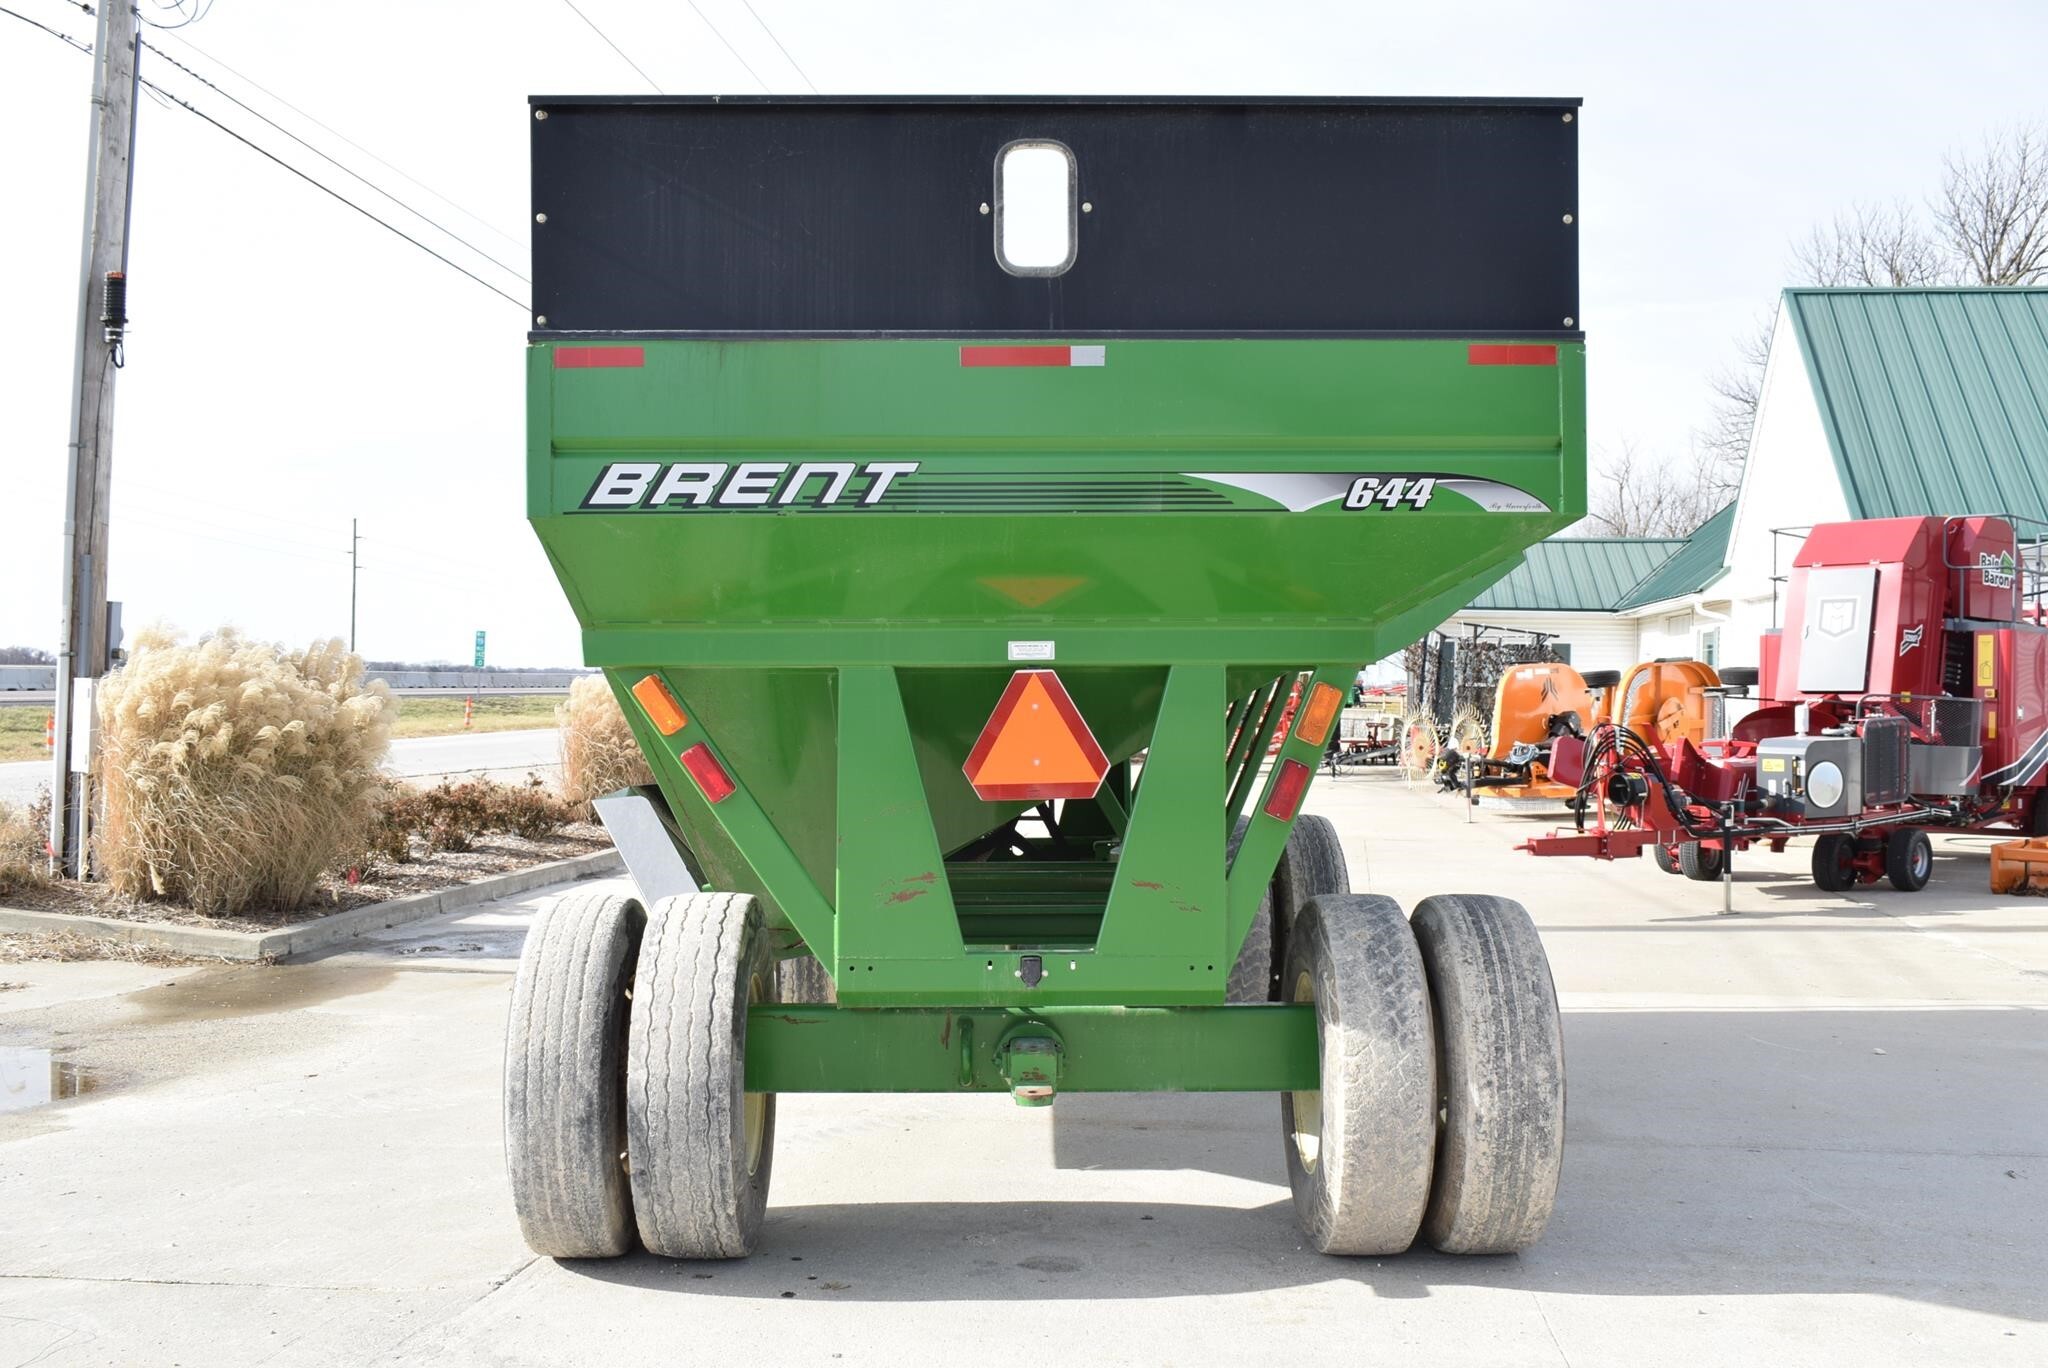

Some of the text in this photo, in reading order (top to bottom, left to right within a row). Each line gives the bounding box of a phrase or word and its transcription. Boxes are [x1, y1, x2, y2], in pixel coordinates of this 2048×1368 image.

[582, 461, 921, 507] BRENT
[1343, 477, 1436, 510] 644
[1984, 570, 2010, 586] Baron
